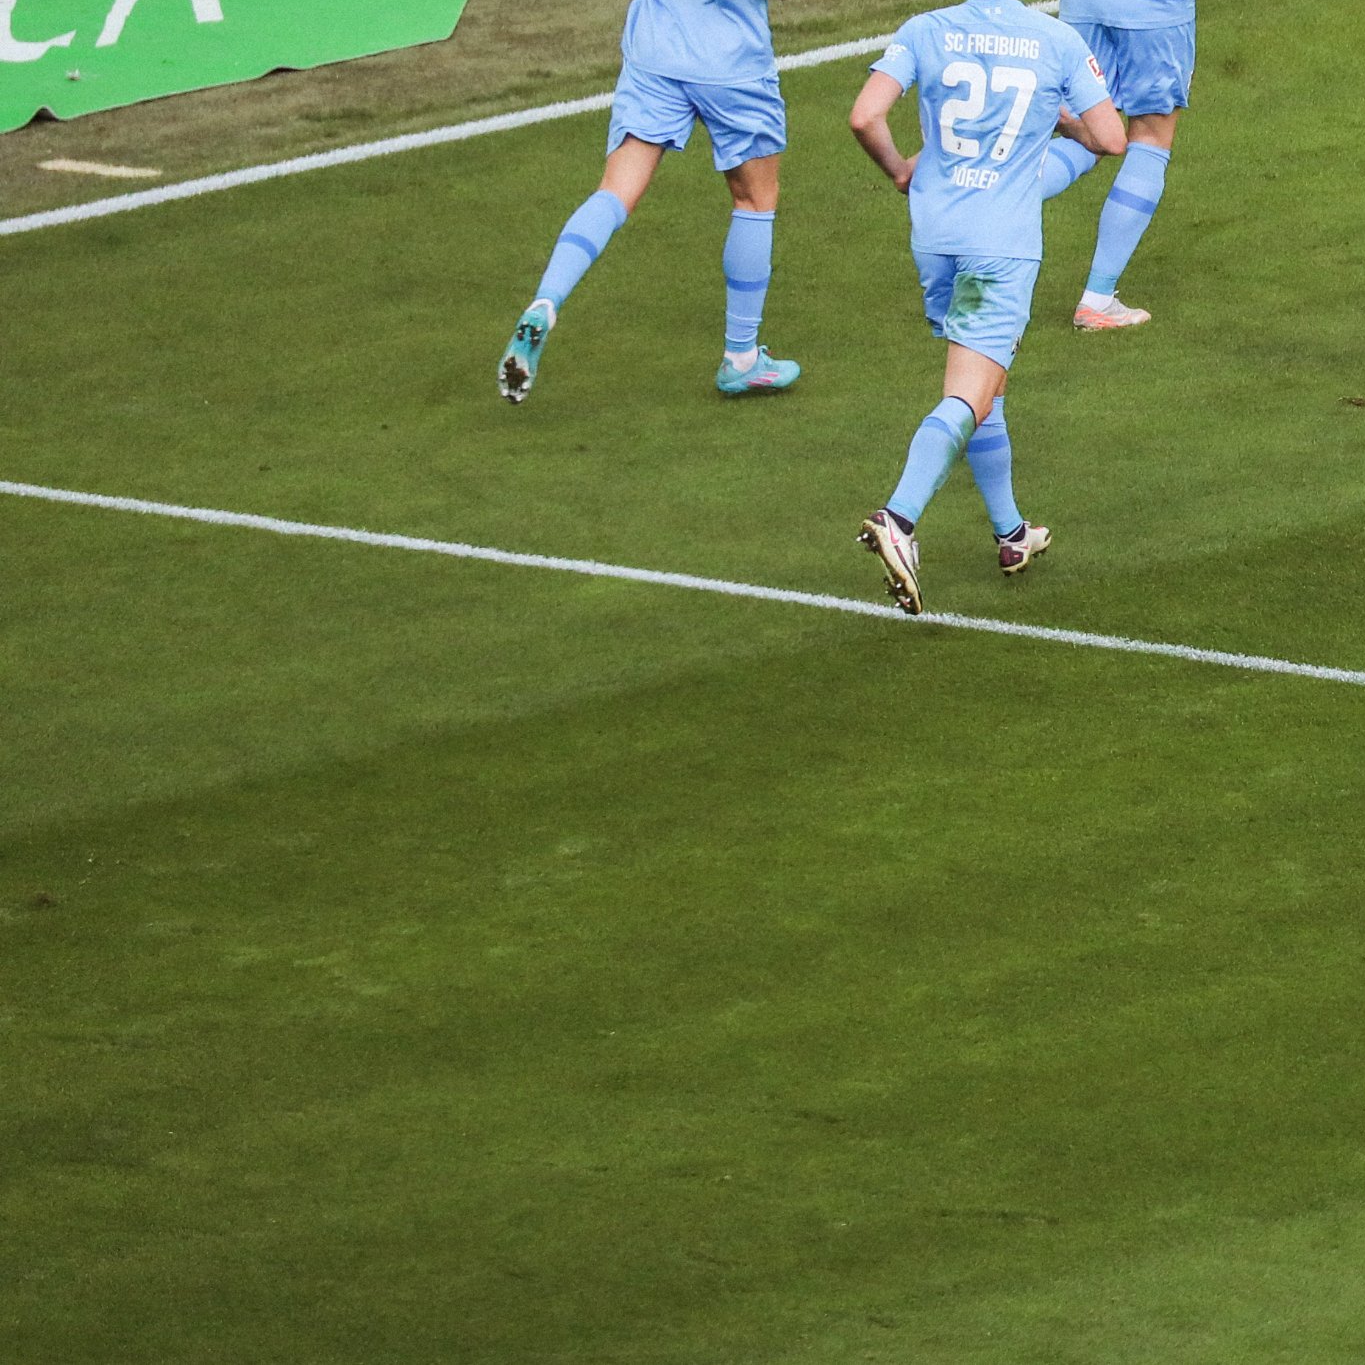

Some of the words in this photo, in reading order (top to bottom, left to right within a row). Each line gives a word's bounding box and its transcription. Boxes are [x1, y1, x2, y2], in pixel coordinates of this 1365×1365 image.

[944, 33, 963, 52] SC
[966, 33, 1040, 60] FREIBURG
[940, 61, 1038, 160] 27
